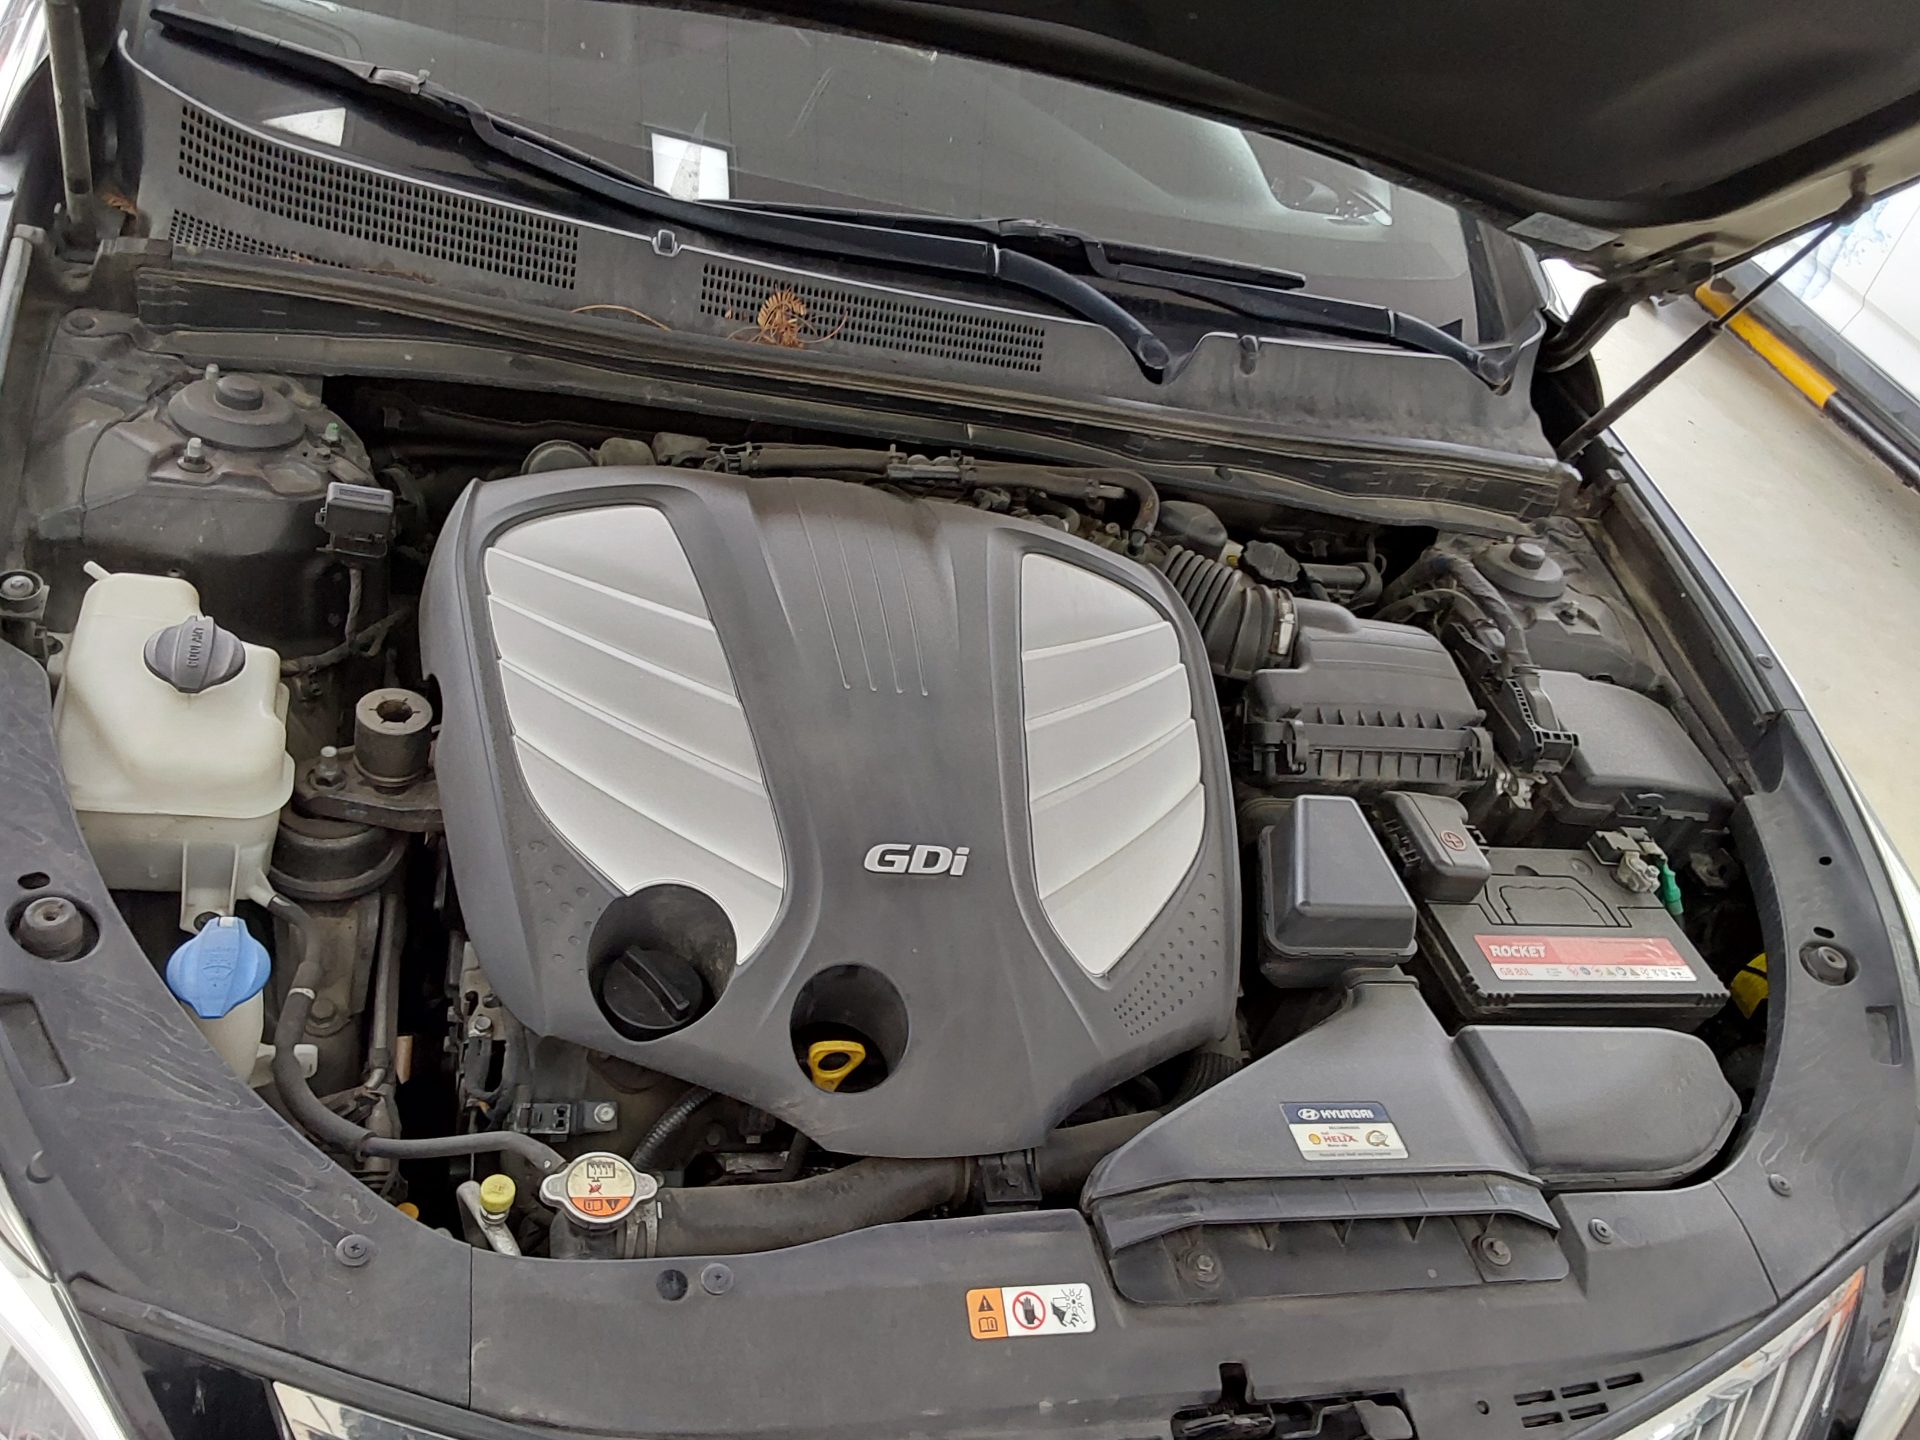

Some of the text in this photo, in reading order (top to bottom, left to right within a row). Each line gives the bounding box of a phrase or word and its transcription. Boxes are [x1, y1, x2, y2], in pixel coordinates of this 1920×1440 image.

[863, 843, 970, 876] GDi
[1488, 945, 1546, 958] ROCKET
[1320, 1109, 1375, 1119] HYUNDAI
[1323, 1134, 1356, 1143] HELIX
